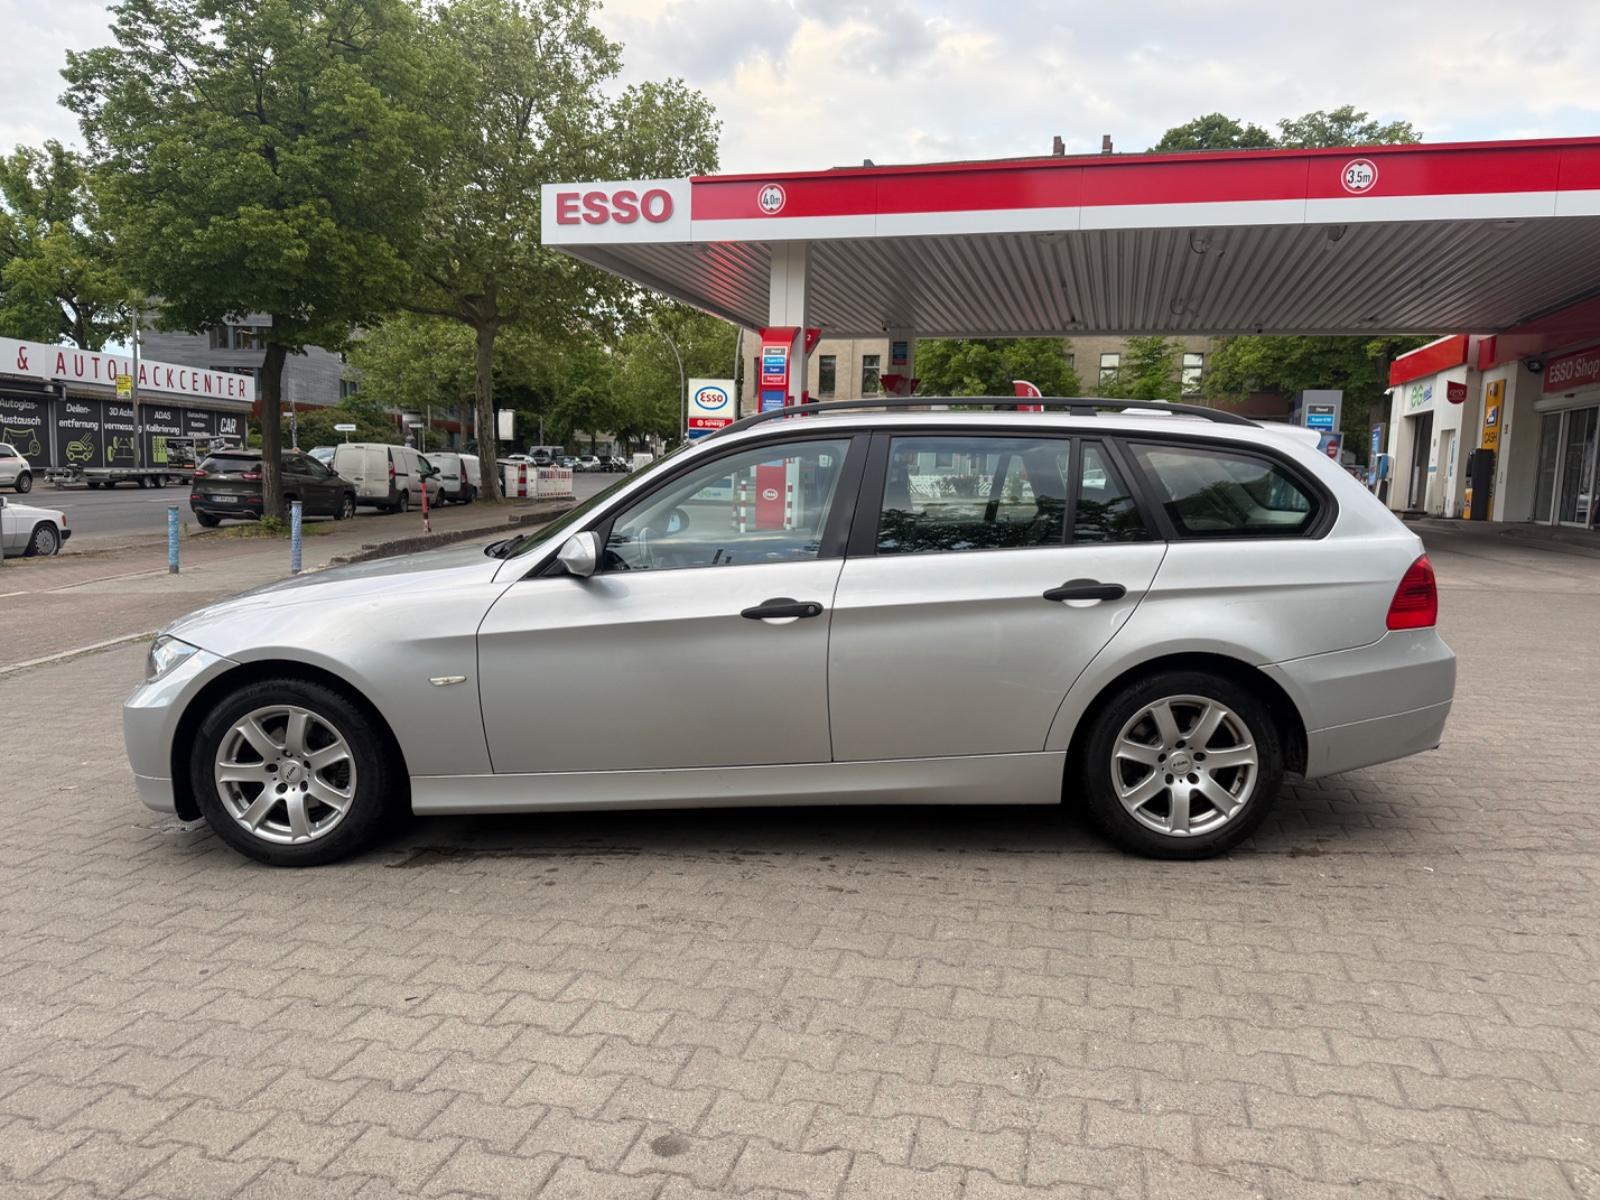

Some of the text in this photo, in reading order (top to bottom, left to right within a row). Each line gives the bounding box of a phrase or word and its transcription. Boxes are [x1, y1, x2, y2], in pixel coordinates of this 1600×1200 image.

[556, 189, 674, 225] ESSO
[17, 346, 29, 370] &
[1549, 357, 1600, 384] ESSO Shop
[700, 391, 724, 403] Esso
[59, 418, 99, 431] entfernung
[220, 417, 237, 433] CAR
